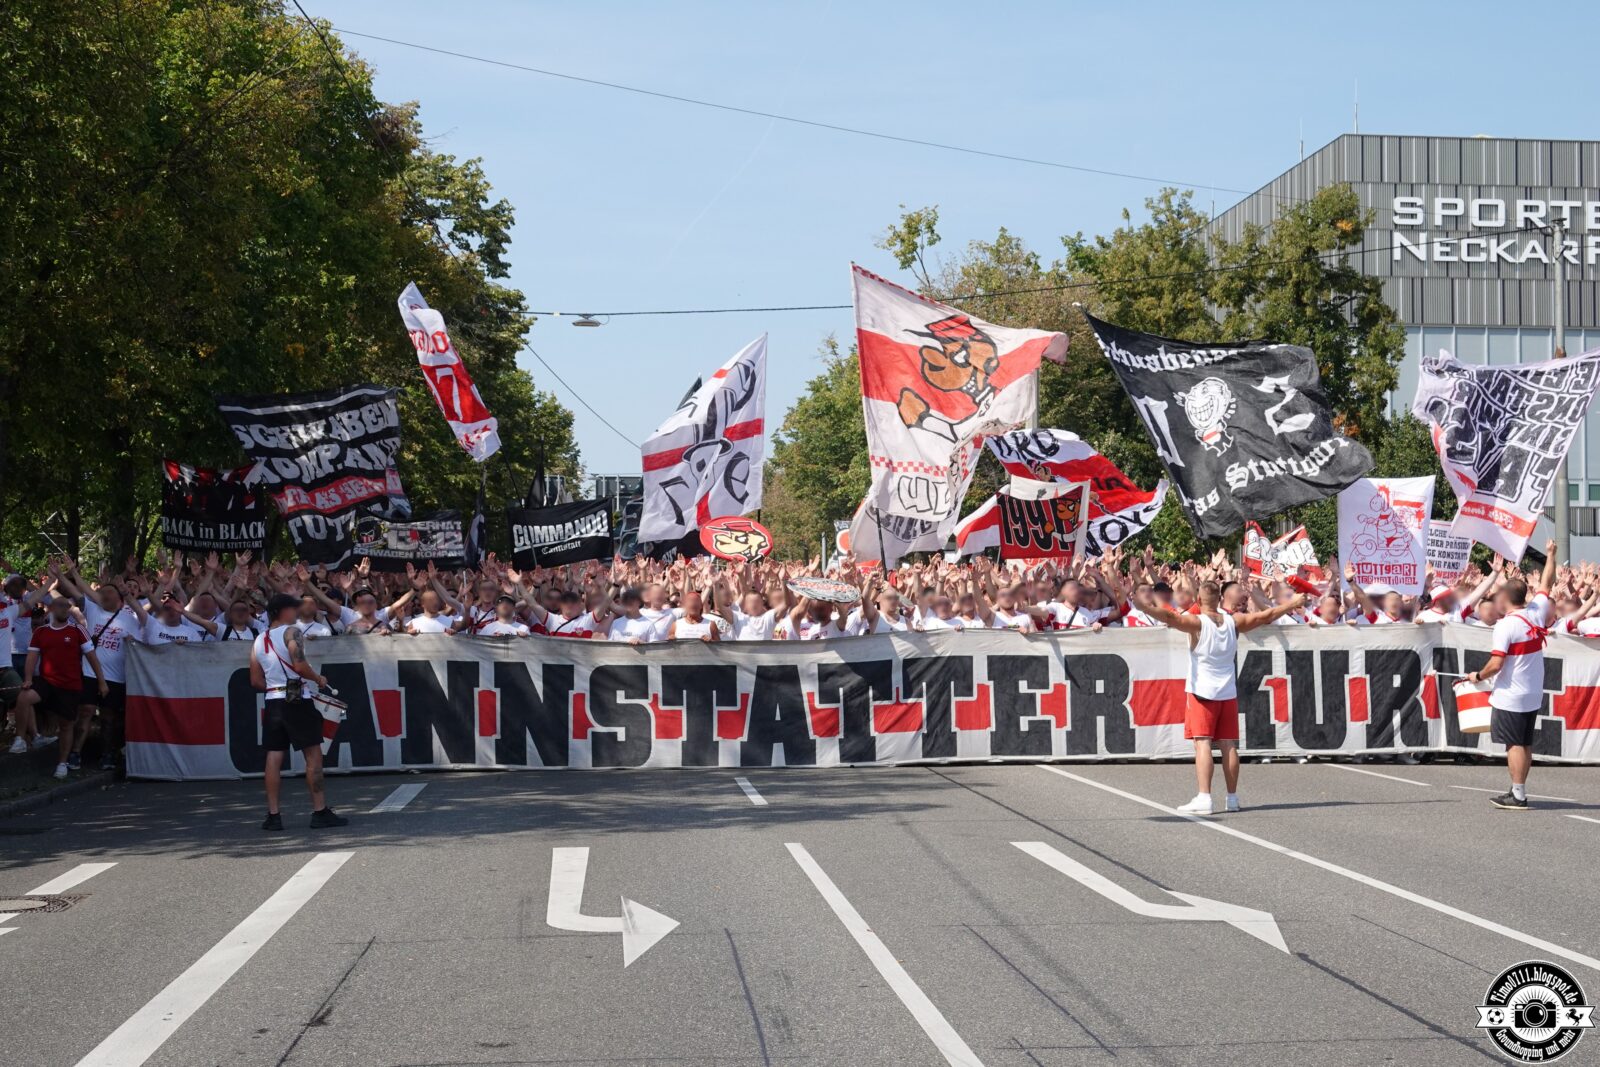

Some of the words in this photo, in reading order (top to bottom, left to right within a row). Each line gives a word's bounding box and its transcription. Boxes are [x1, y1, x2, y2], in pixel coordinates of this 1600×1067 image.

[160, 517, 195, 537] BACK
[199, 523, 214, 539] in
[219, 521, 266, 540] BLACK
[513, 510, 608, 548] COMMANDO
[228, 653, 1136, 775] CANNSTATTER
